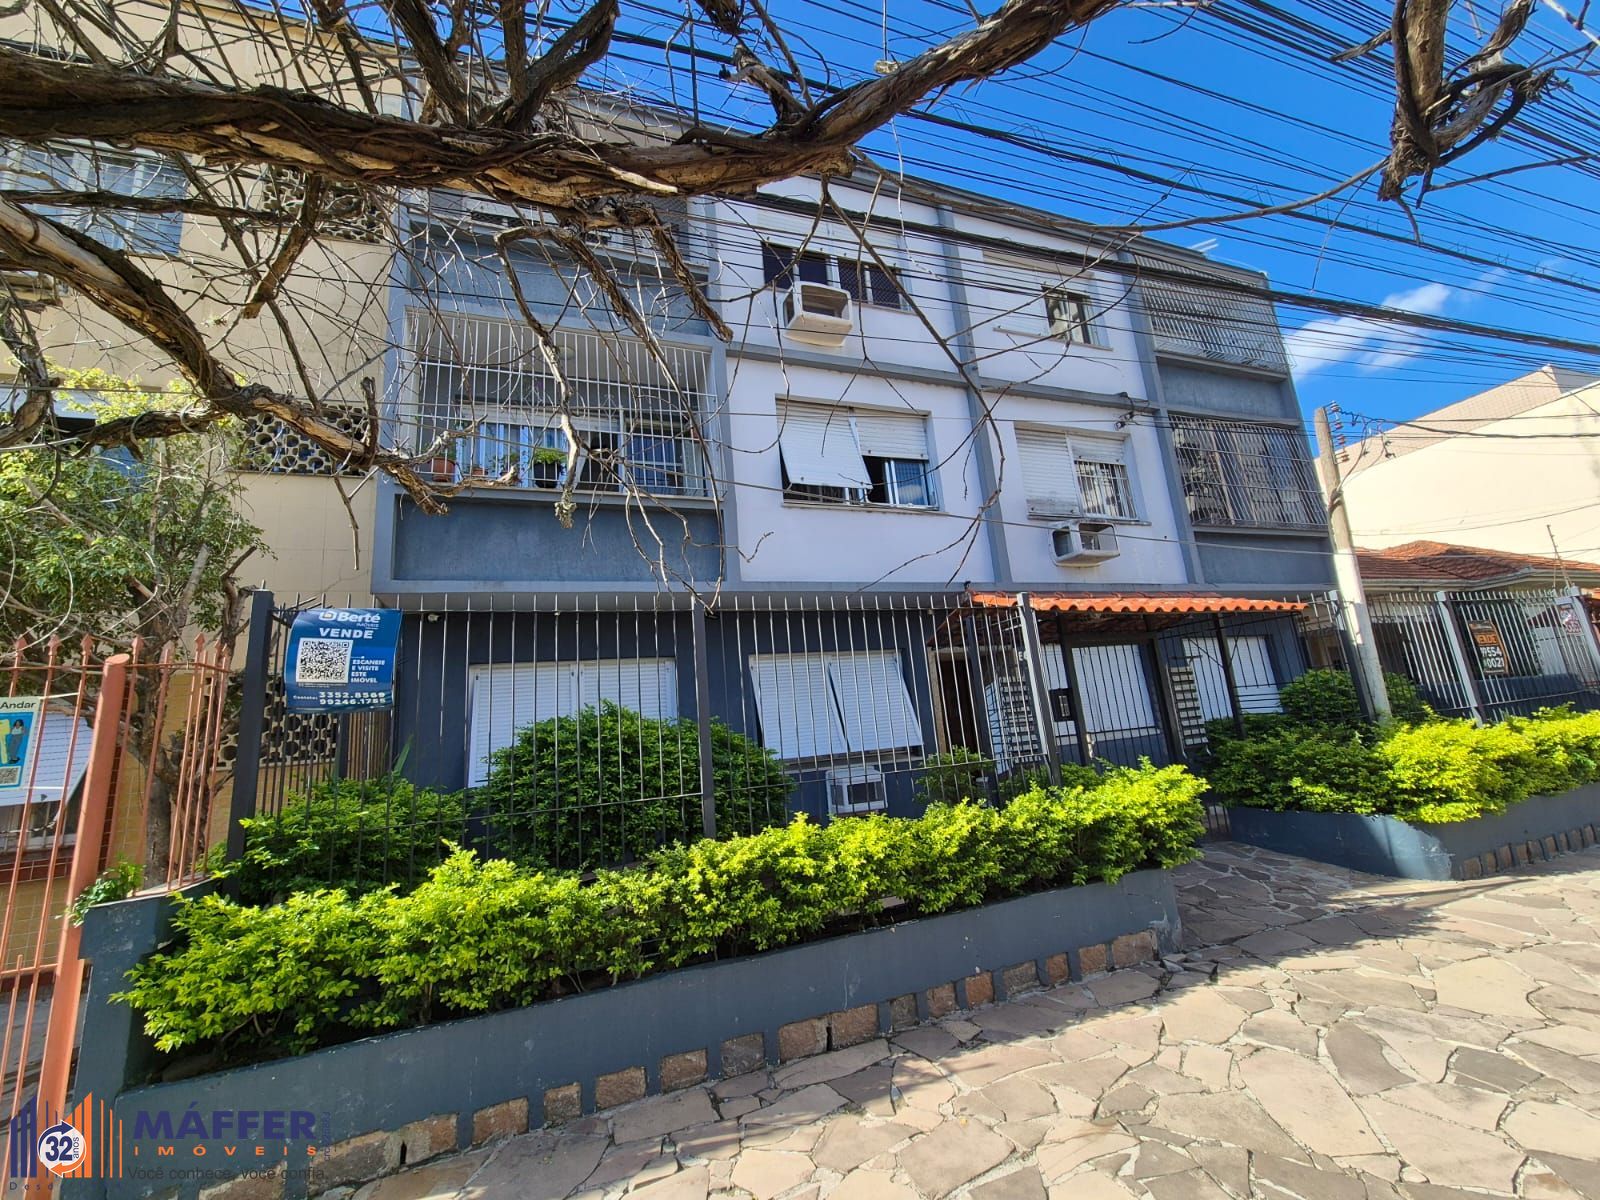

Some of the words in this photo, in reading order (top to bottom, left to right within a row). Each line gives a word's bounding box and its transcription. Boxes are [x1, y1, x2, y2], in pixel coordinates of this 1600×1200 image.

[337, 611, 380, 623] Berté
[319, 627, 374, 639] VENDE
[0, 701, 36, 709] Andar
